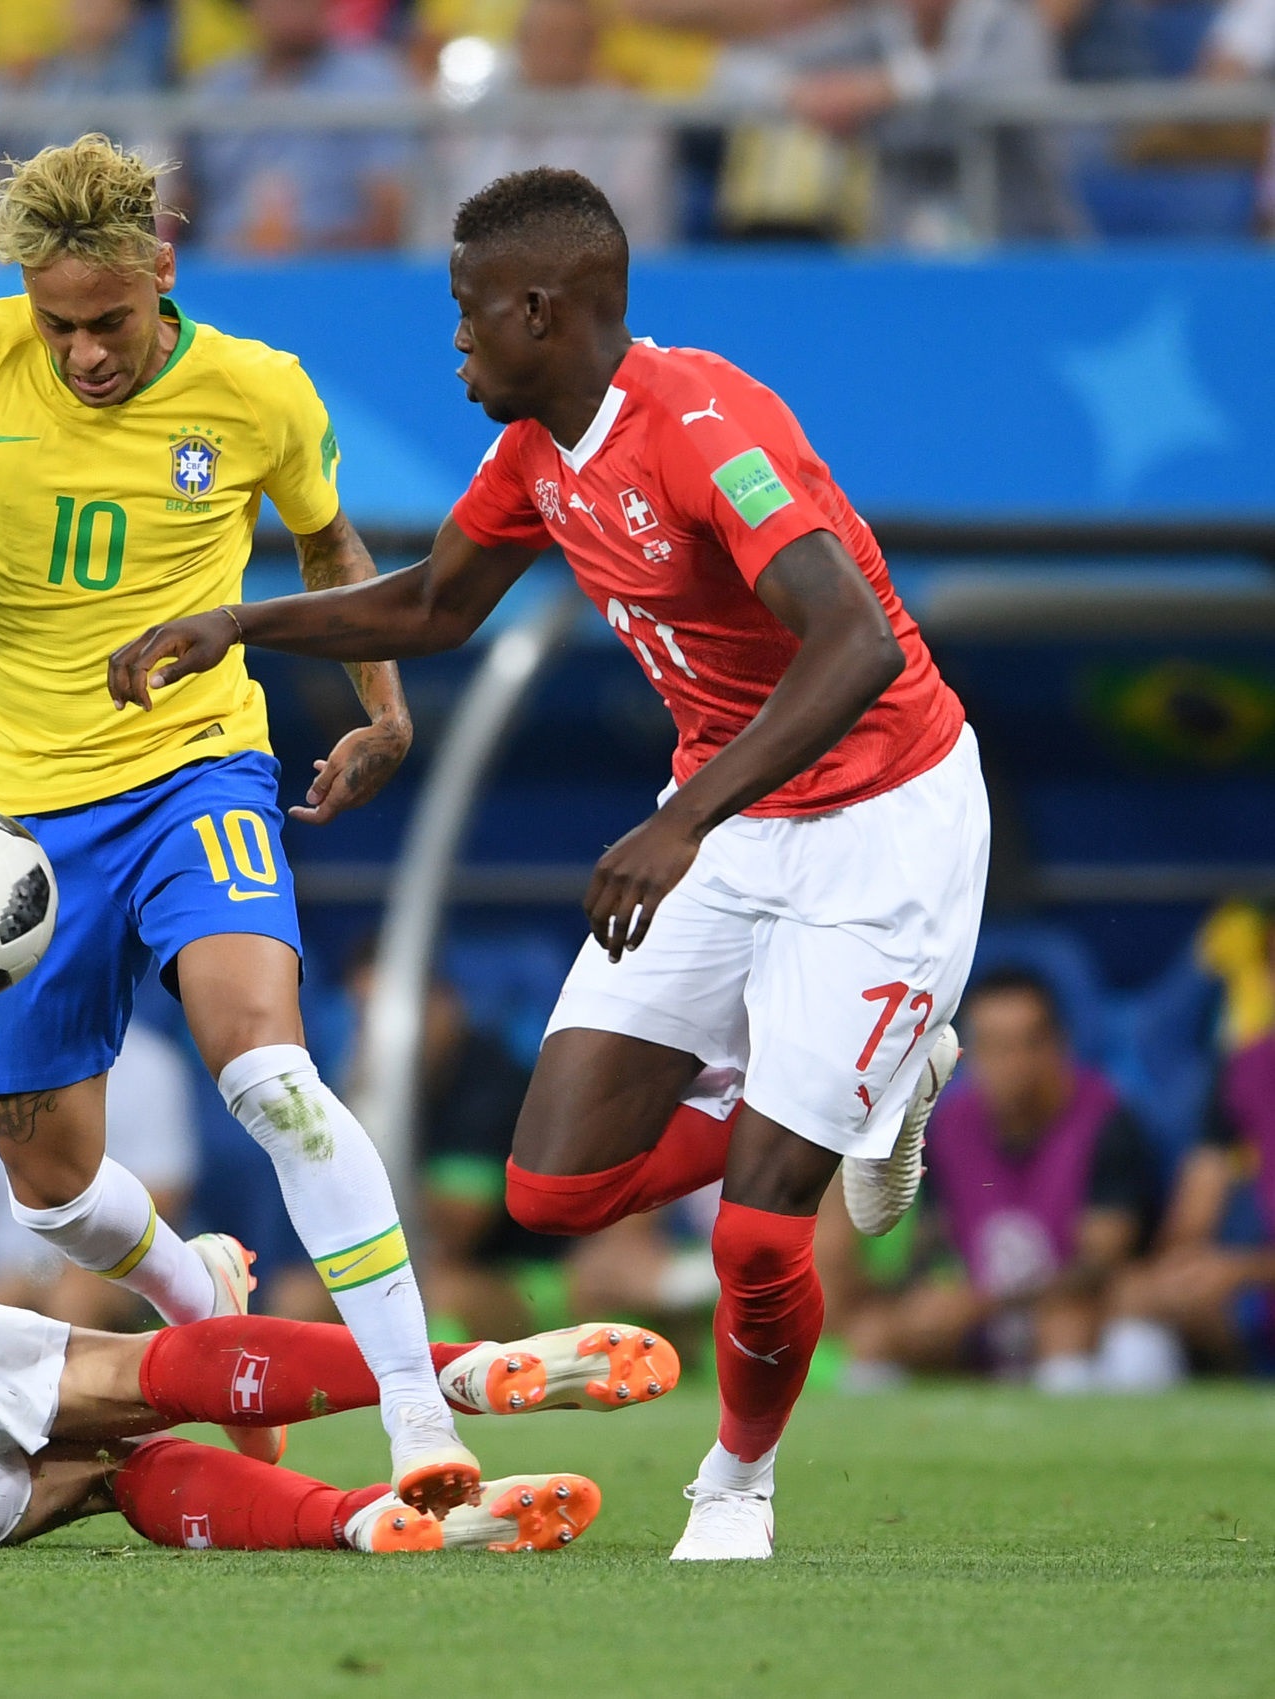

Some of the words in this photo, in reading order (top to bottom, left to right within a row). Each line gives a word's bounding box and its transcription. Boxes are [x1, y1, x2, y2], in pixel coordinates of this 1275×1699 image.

[185, 462, 202, 470] CBF
[165, 499, 212, 513] BRASIL
[48, 495, 127, 591] 10
[192, 809, 277, 886] 10
